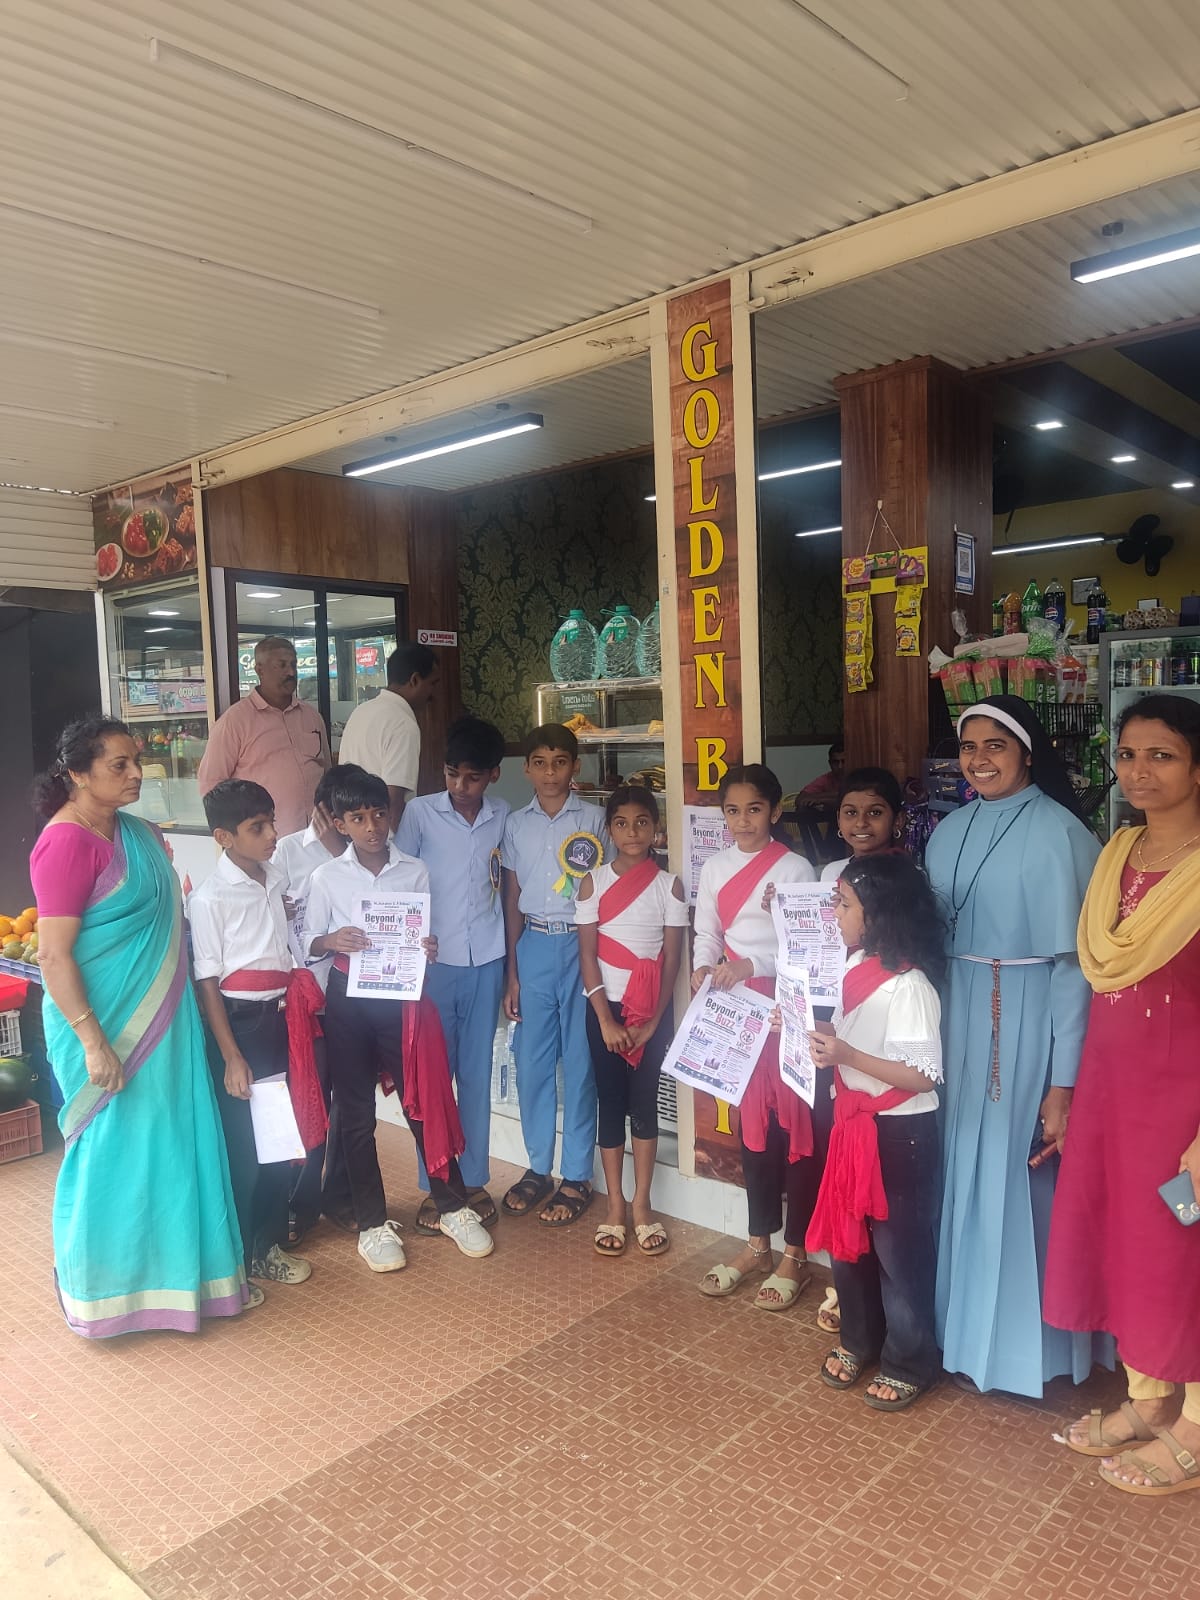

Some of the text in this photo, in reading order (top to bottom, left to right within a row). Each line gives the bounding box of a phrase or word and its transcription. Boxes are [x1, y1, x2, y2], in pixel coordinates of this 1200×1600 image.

[681, 319, 728, 709] GOLDEN
[365, 913, 395, 924] Beyond
[783, 908, 811, 920] Beyond
[379, 922, 398, 932] Buzz
[798, 918, 816, 929] Buzz
[705, 998, 737, 1019] Beyond
[715, 1013, 736, 1029] Buzz
